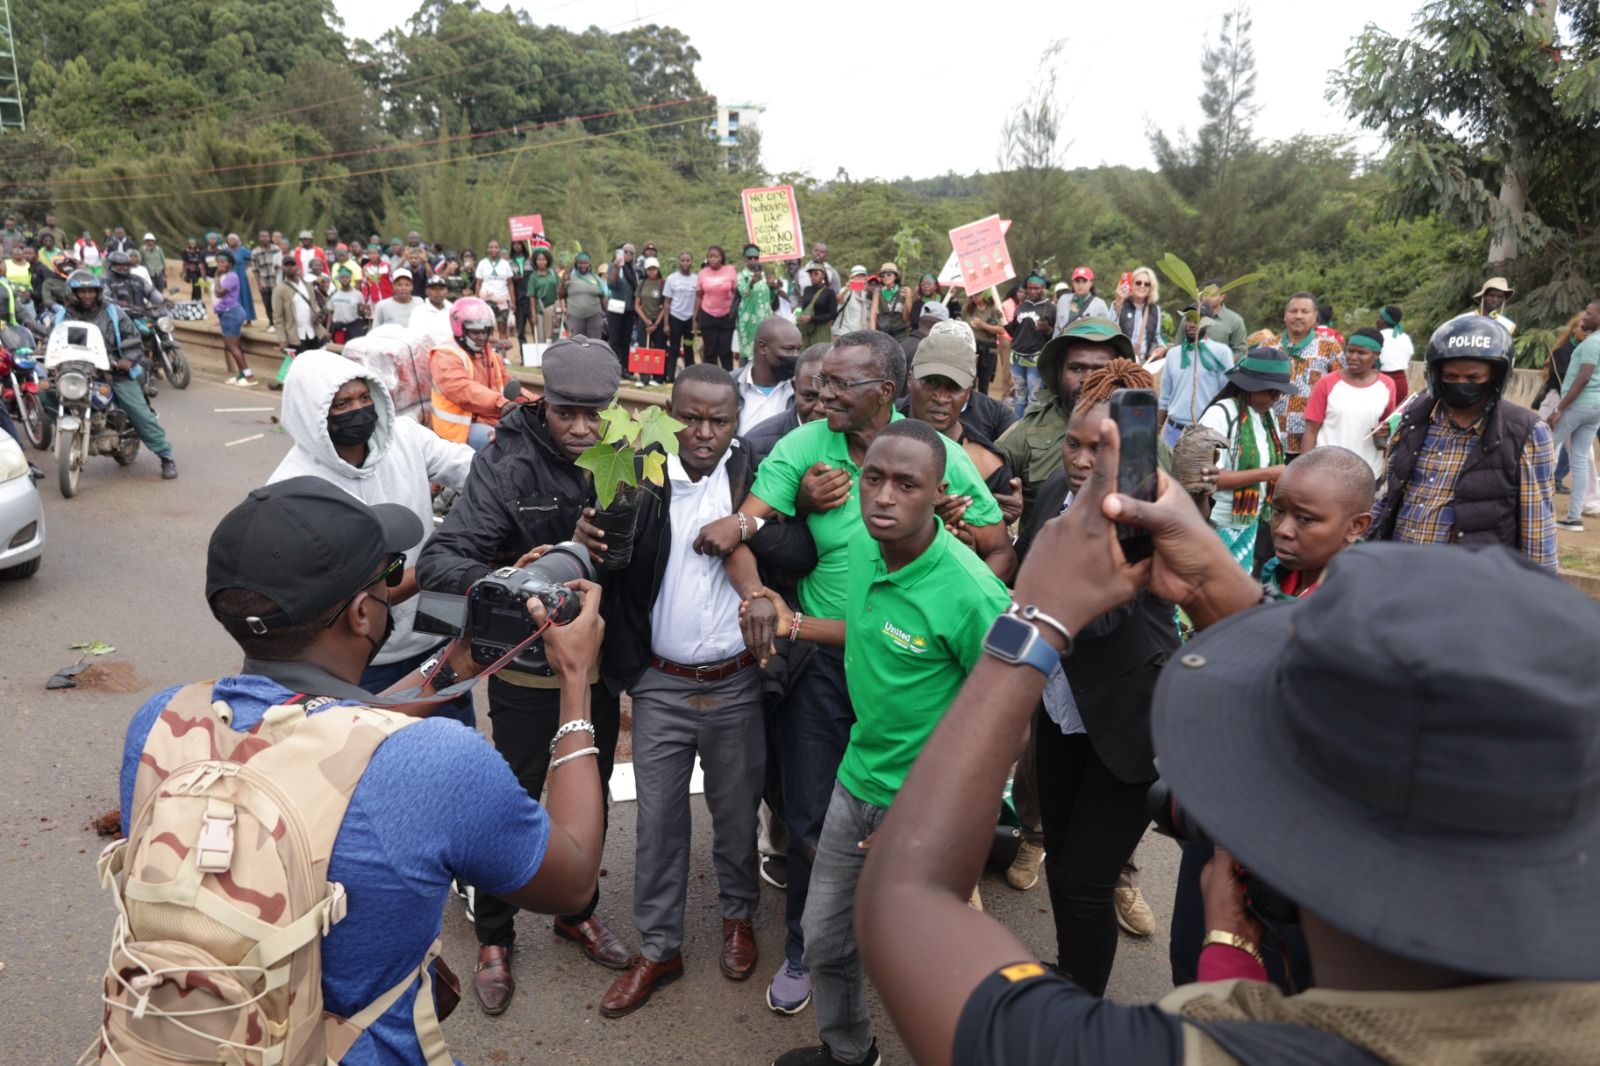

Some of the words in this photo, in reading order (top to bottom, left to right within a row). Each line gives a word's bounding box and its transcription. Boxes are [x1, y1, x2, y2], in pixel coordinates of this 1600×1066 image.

[750, 192, 763, 202] We
[767, 190, 786, 200] are
[777, 231, 793, 242] NO
[759, 243, 795, 256] HILDREN
[1448, 335, 1491, 349] POLICE
[884, 622, 911, 642] United
